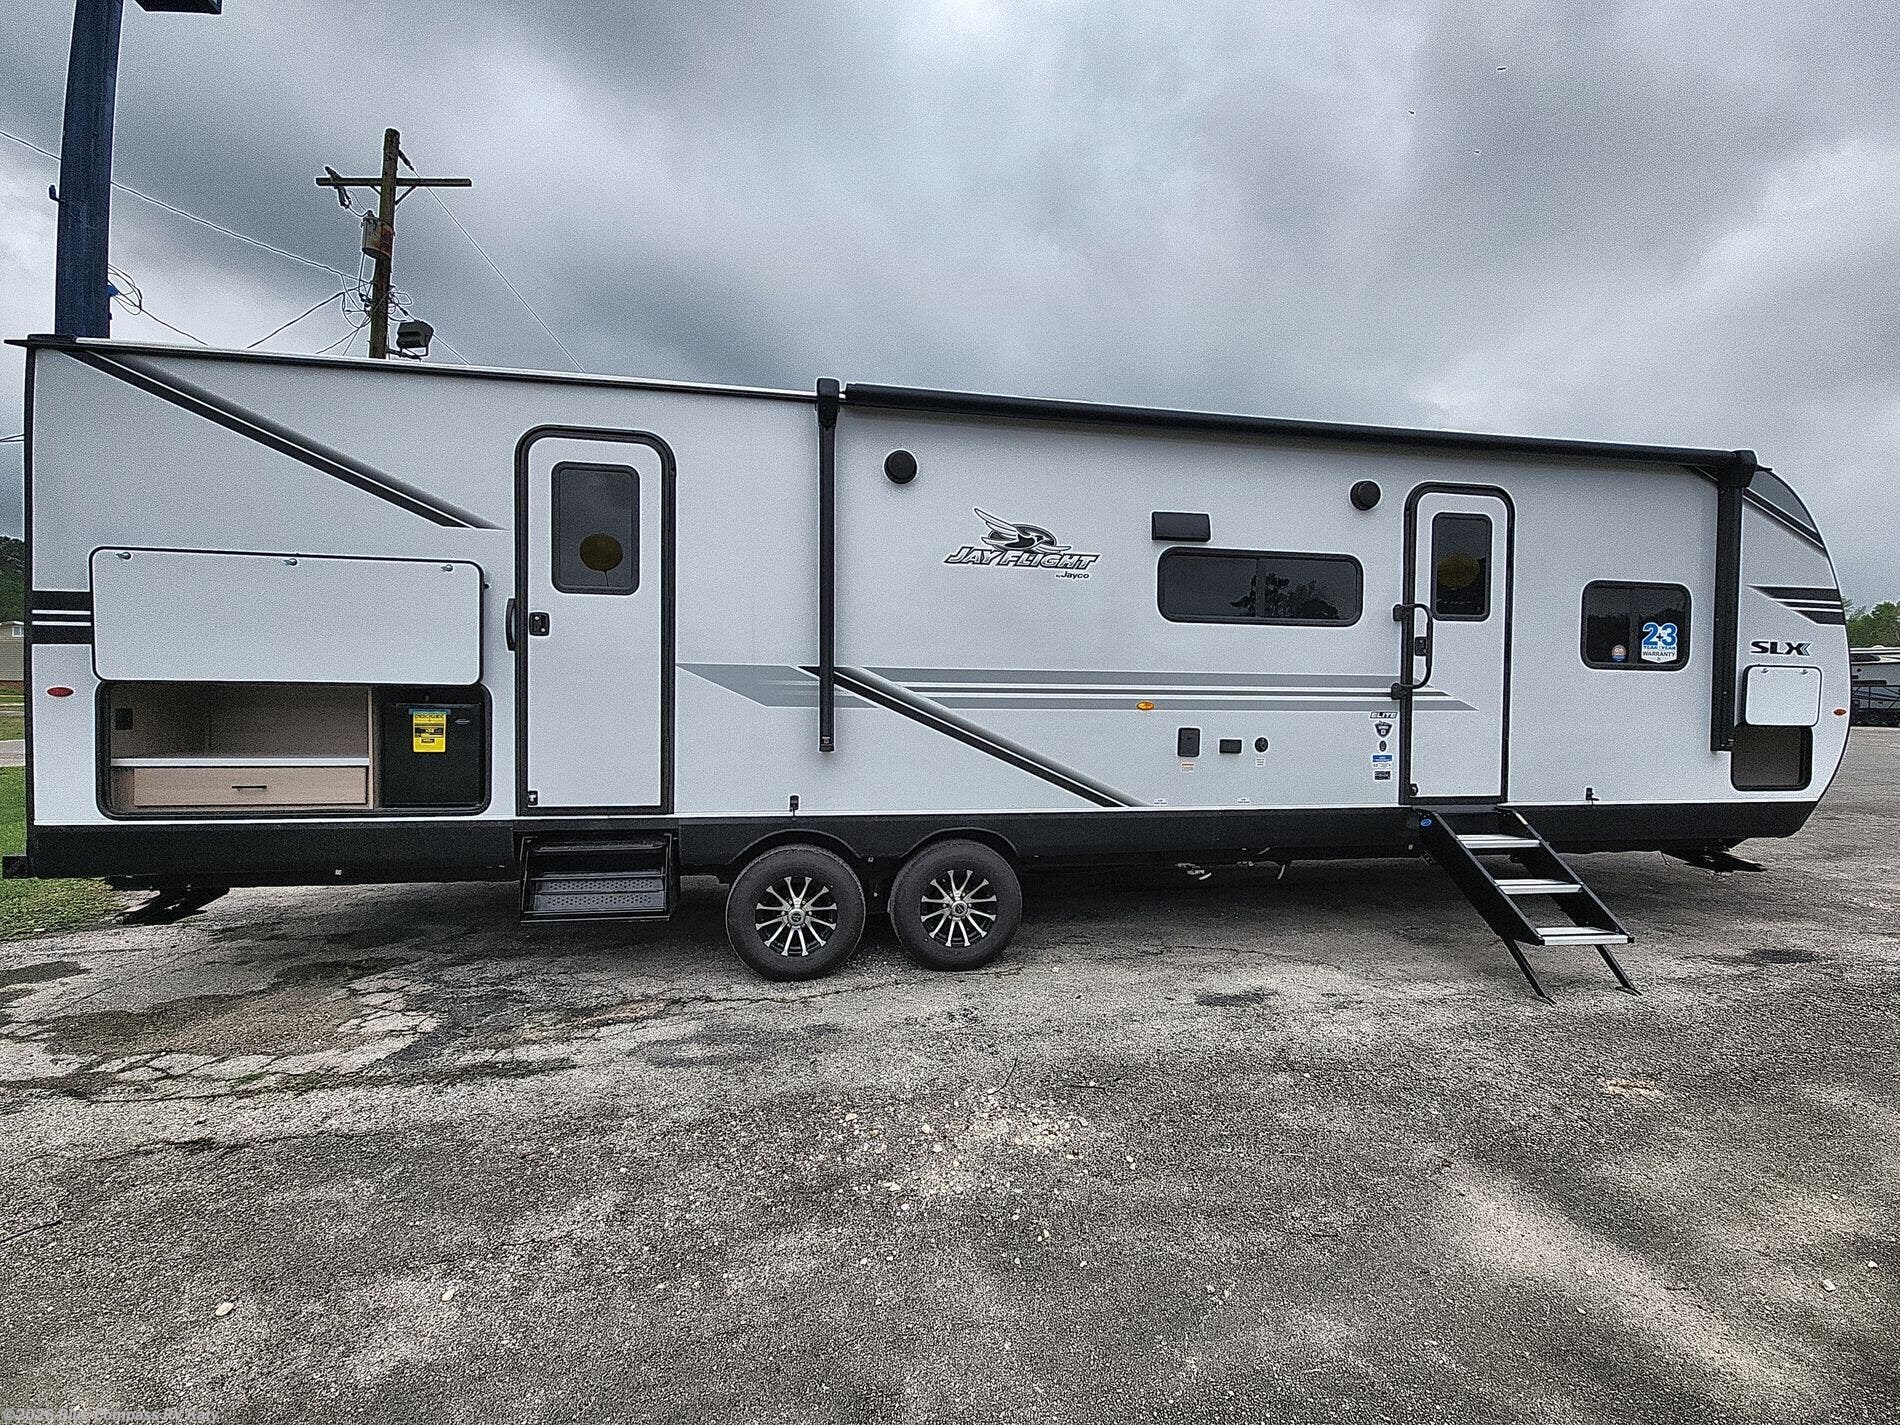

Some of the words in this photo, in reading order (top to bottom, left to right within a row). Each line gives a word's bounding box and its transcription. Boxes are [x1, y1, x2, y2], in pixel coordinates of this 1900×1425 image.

[944, 546, 1002, 565] JAY
[996, 550, 1099, 569] FLIGHT
[1060, 571, 1090, 579] Jayco
[1750, 640, 1811, 656] SLX
